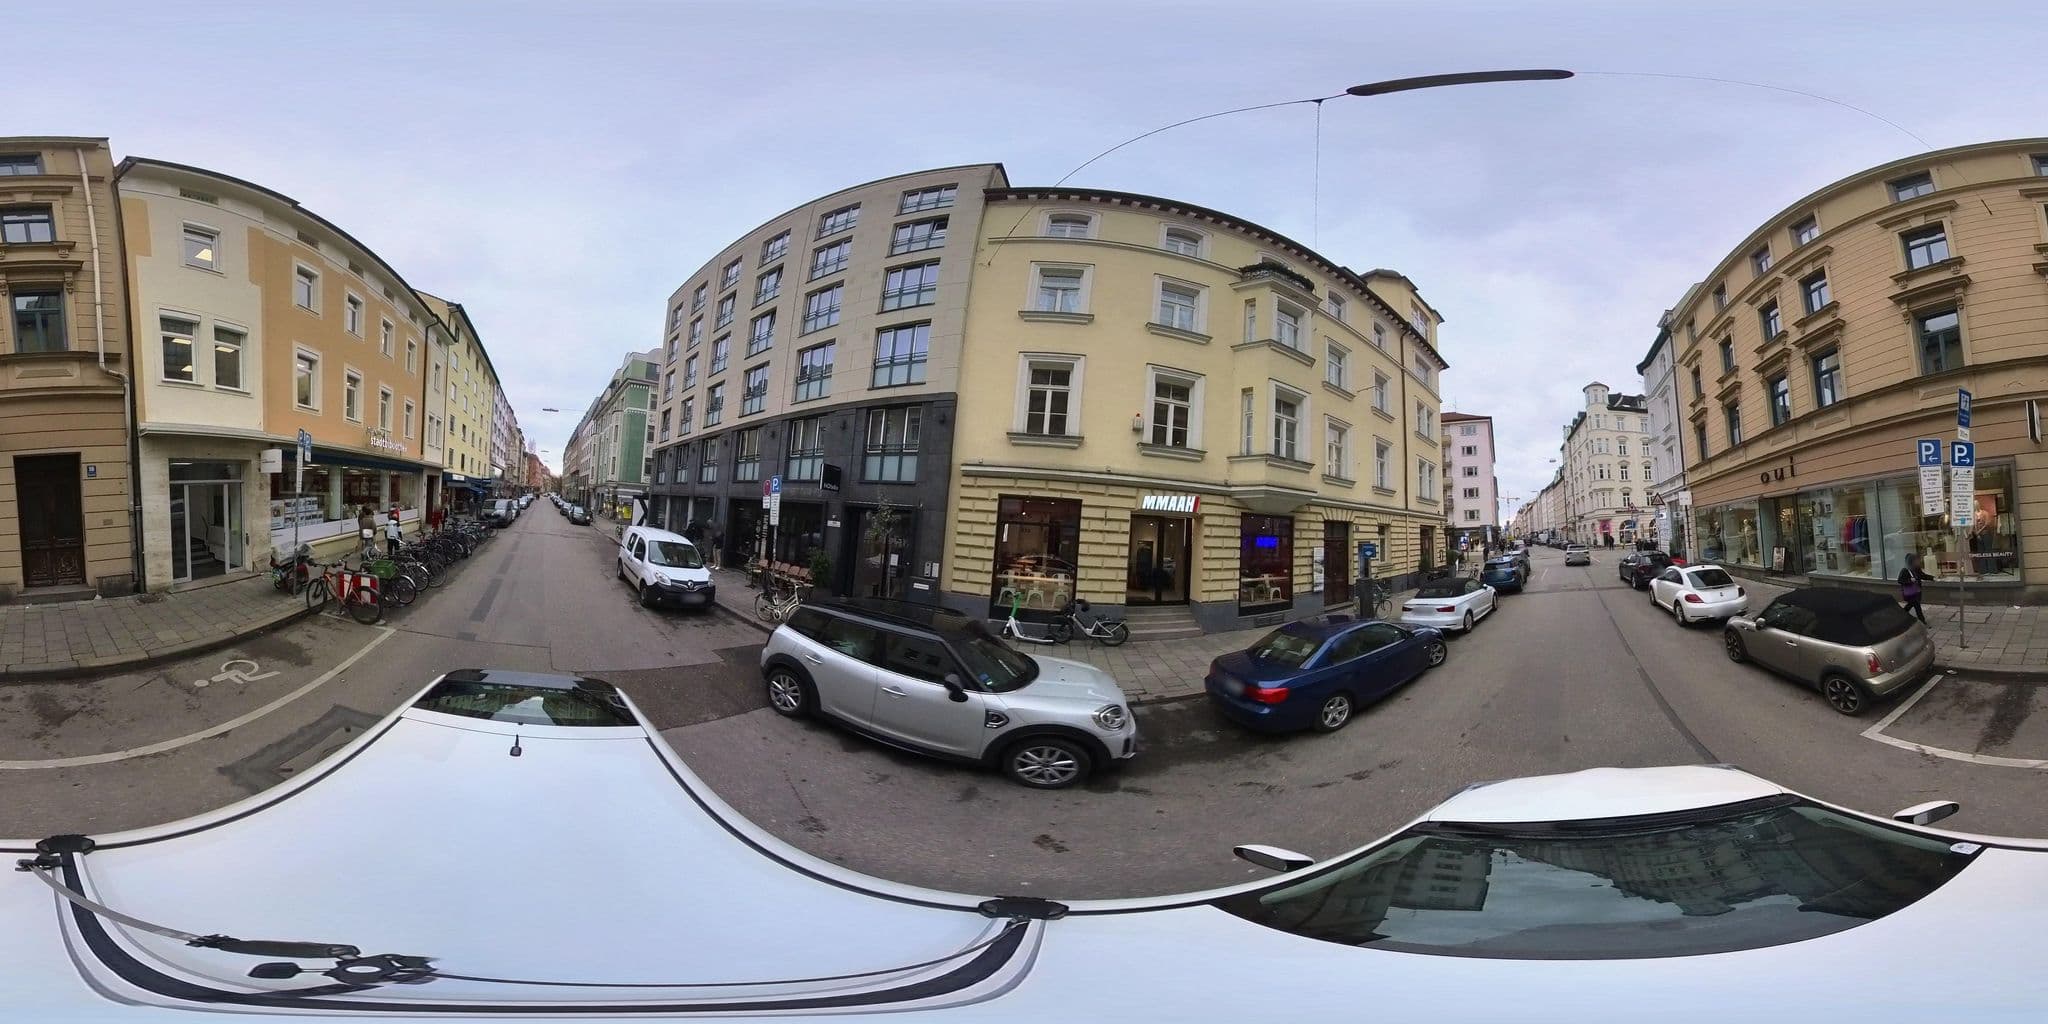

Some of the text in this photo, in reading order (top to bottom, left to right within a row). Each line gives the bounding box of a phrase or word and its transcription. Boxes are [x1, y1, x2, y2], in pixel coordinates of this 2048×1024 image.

[1921, 442, 1935, 463] P
[1954, 444, 1968, 464] P
[1760, 455, 1795, 484] oui
[772, 478, 779, 492] P
[1142, 495, 1196, 513] MMAAH
